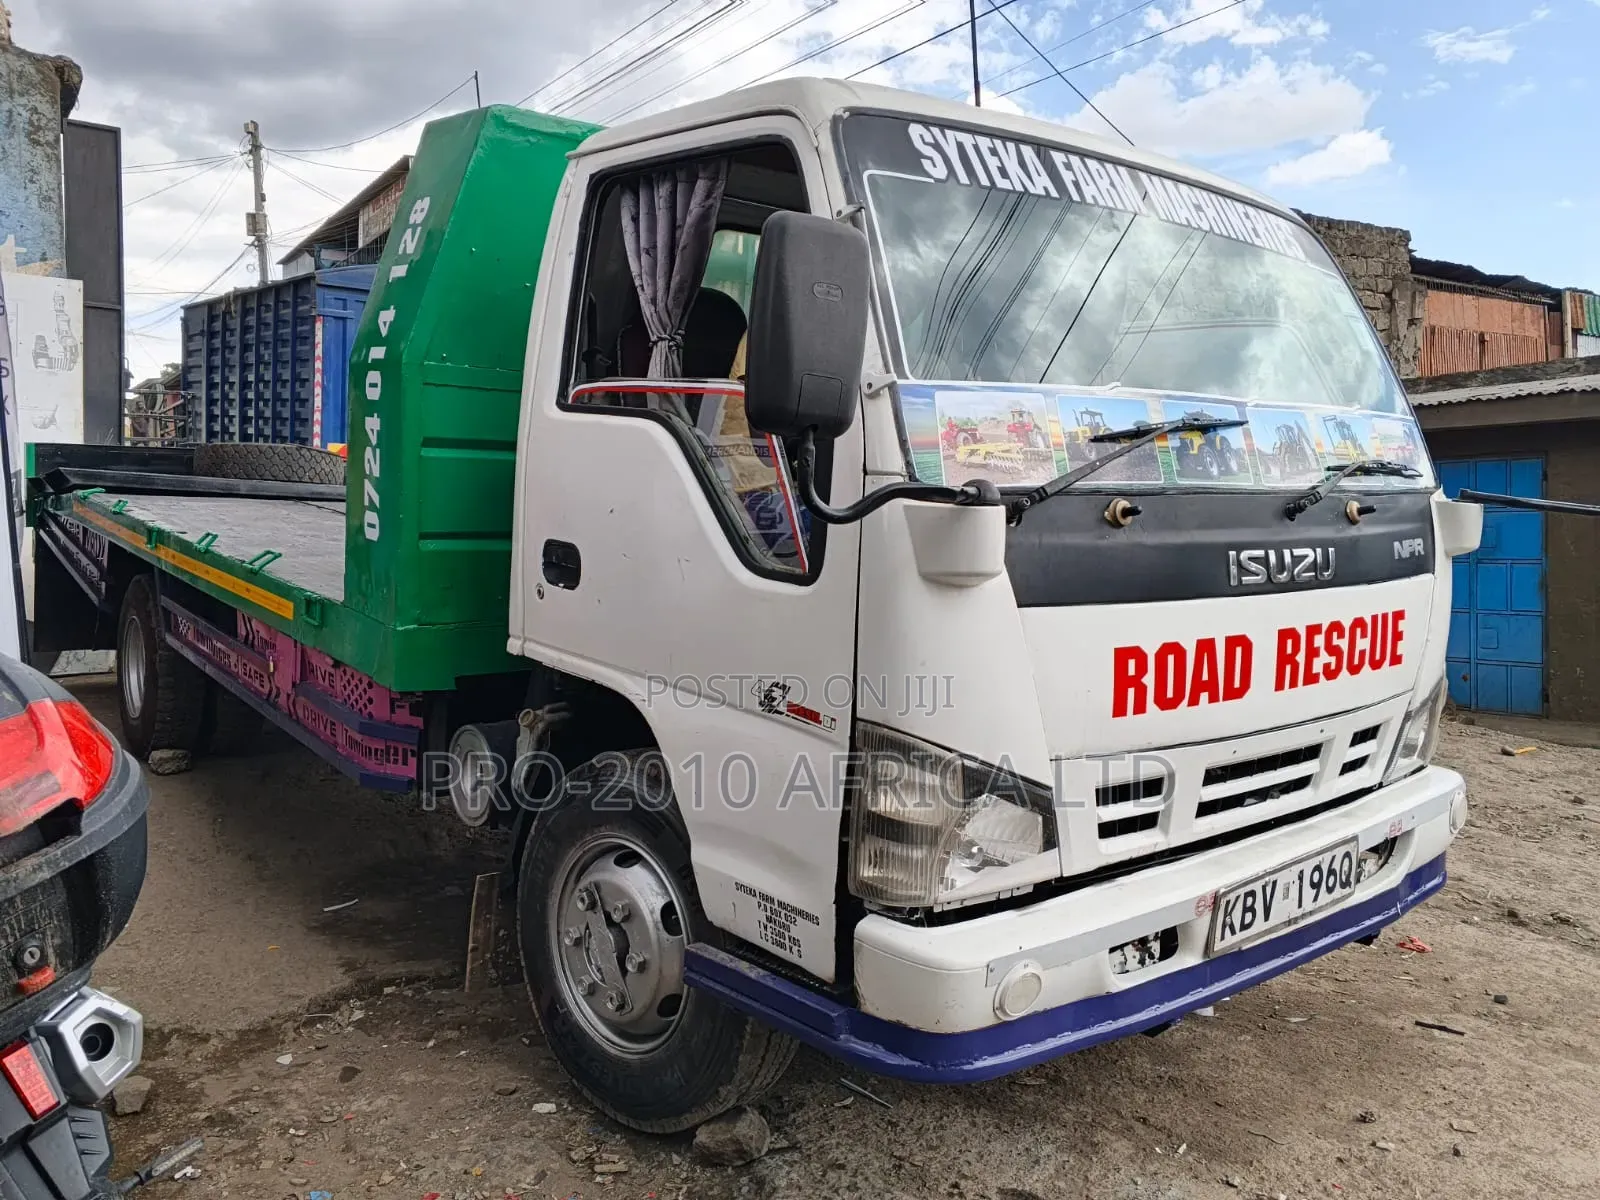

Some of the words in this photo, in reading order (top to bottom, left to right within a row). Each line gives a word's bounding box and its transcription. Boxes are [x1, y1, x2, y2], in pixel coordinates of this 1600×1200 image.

[907, 122, 1060, 199] SYTEKA
[1049, 150, 1147, 216] FARM
[1136, 169, 1307, 263] MACHINERIES
[388, 196, 431, 284] 128
[365, 305, 396, 401] 014
[364, 413, 381, 542] 0724
[1228, 547, 1336, 587] ISUZU
[1393, 538, 1425, 560] NPR
[243, 662, 265, 689] SAFE
[1112, 634, 1254, 718] ROAD
[1274, 609, 1406, 692] RESCUE
[302, 703, 337, 738] DRIVE
[734, 881, 757, 898] SYTEKA
[758, 891, 776, 906] FARM
[776, 898, 820, 926] MACHINERIES
[769, 906, 783, 920] BOX
[783, 912, 798, 927] 032
[1220, 878, 1278, 942] KBV
[1297, 850, 1353, 910] 196Q
[765, 914, 791, 933] NAKURU
